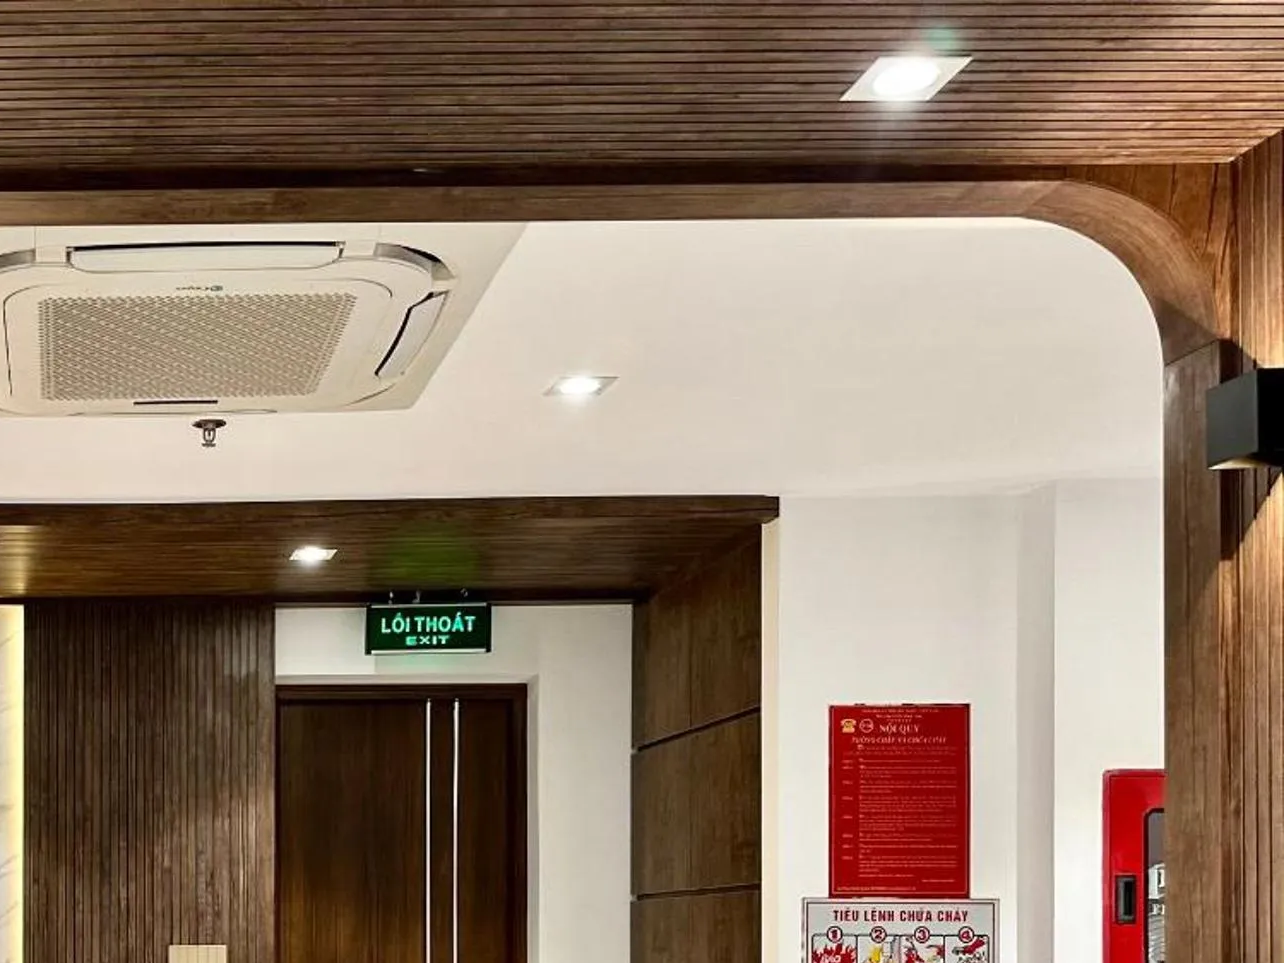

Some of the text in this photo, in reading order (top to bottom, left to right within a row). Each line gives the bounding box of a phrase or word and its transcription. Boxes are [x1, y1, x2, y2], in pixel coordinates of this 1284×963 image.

[414, 611, 476, 633] THOÁT
[405, 635, 450, 646] EXIT
[937, 907, 968, 922] CHÁY
[874, 929, 883, 939] 2
[917, 929, 926, 940] 3
